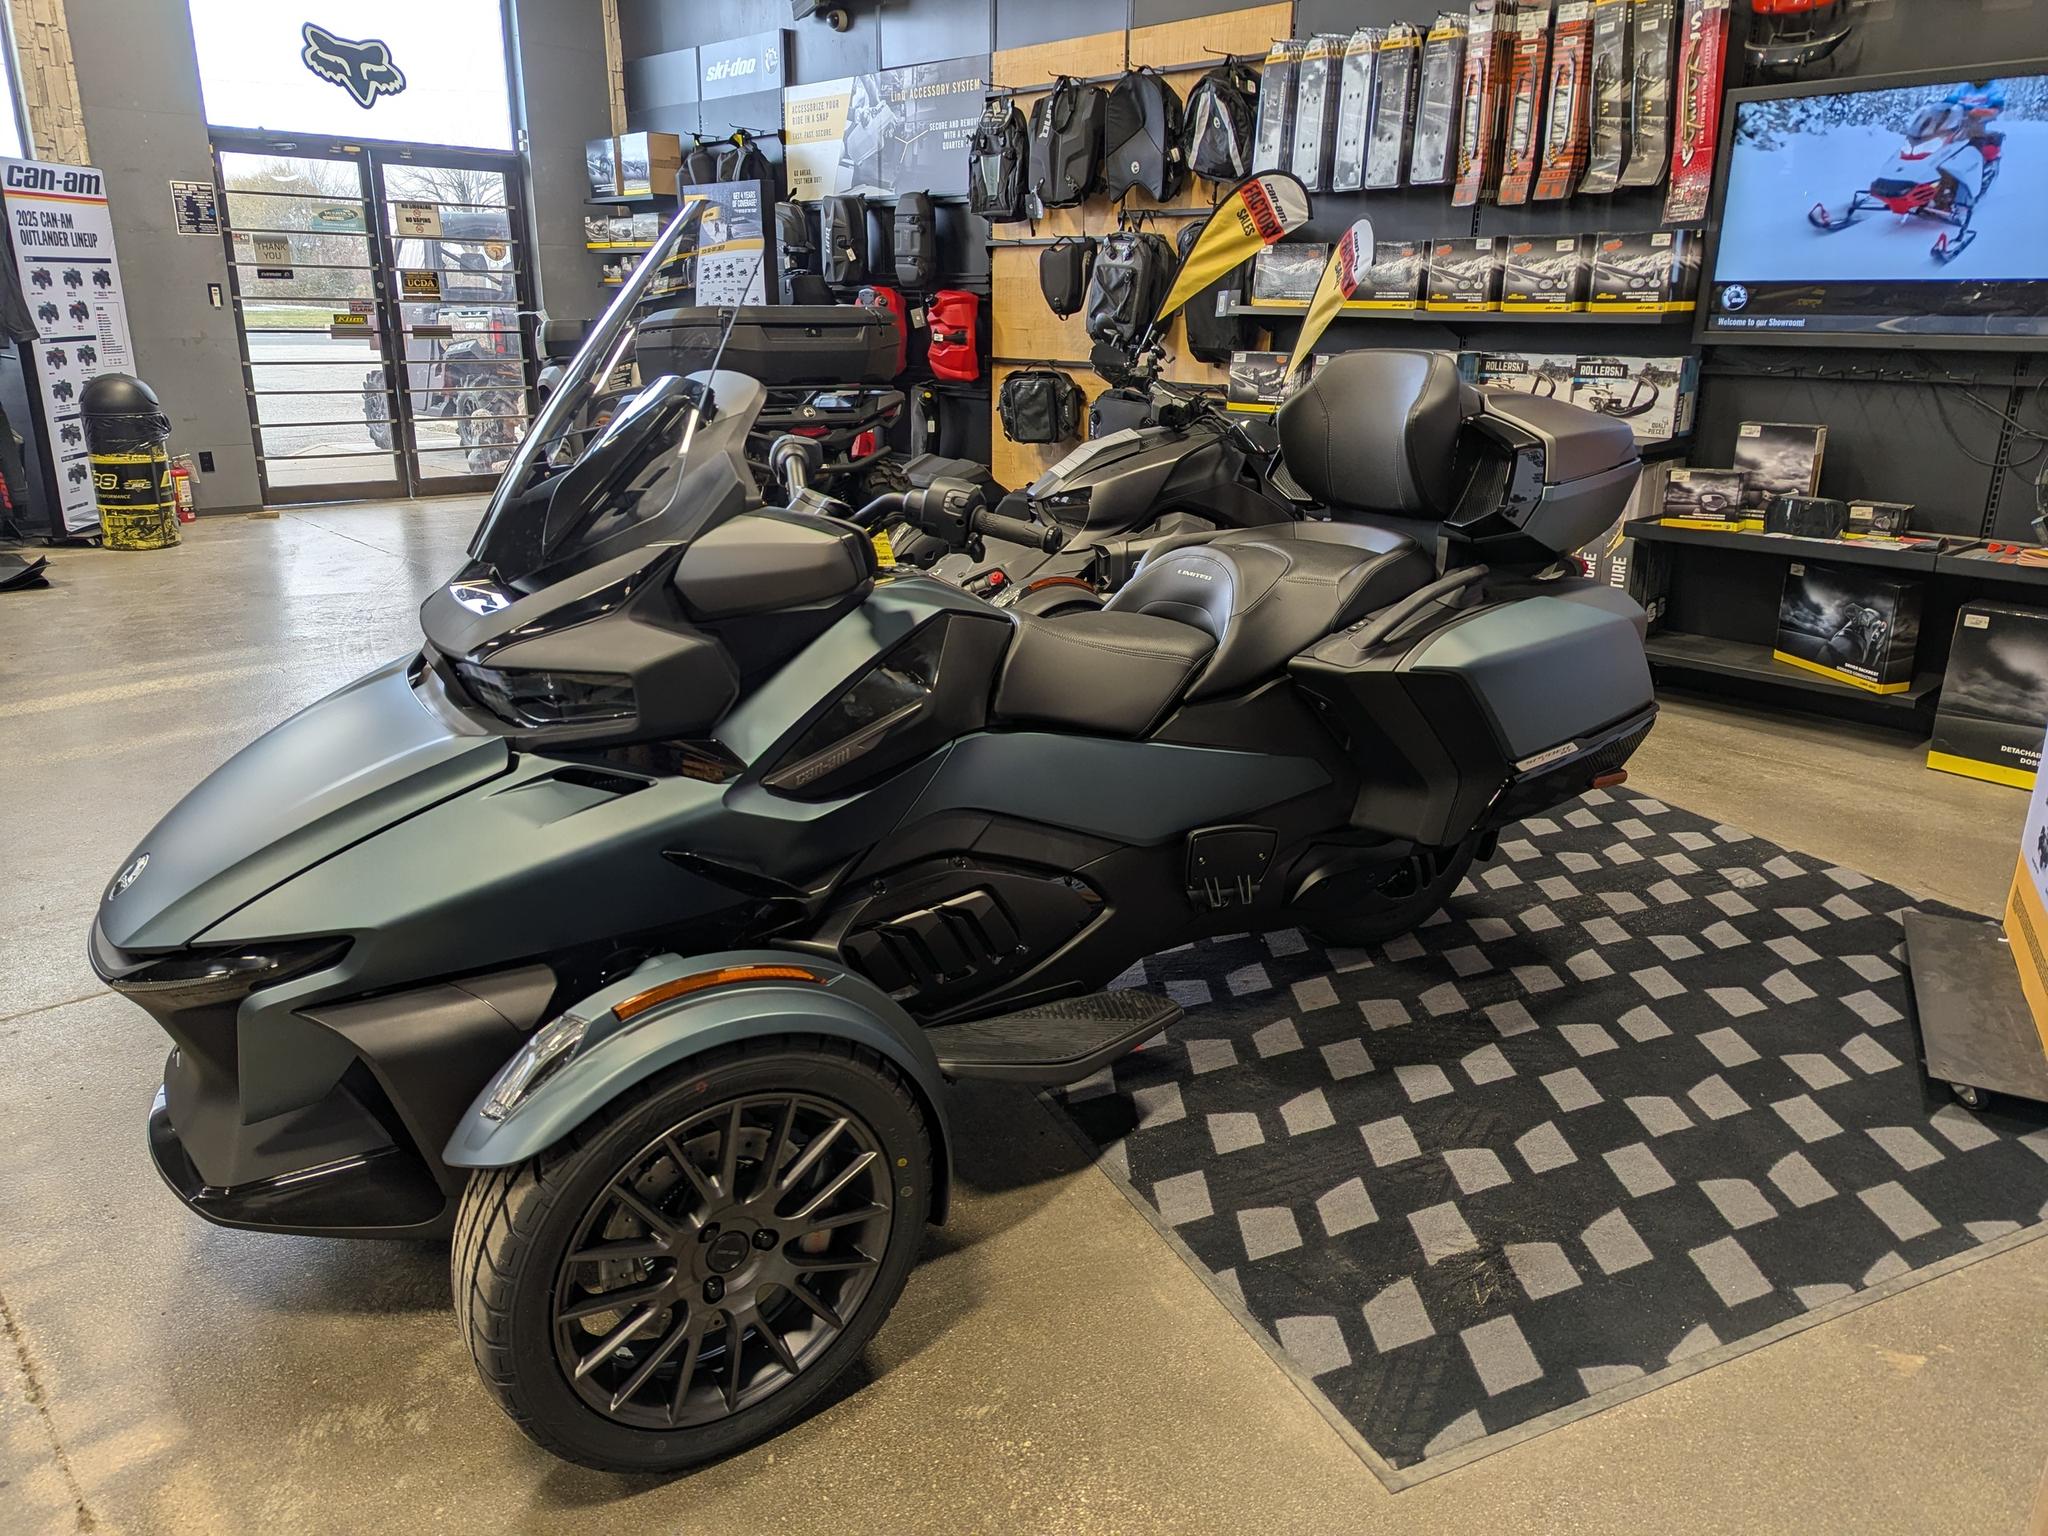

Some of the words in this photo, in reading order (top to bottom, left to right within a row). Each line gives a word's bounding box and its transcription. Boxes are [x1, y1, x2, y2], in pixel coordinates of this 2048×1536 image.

[706, 57, 756, 81] ski-doo
[909, 83, 950, 99] ACCESSORY
[952, 78, 981, 94] SYSTEM
[792, 101, 824, 114] ACCESSORIZE
[826, 99, 839, 109] YOUR
[792, 115, 803, 125] RIDE
[816, 112, 829, 122] SNAP
[929, 120, 948, 131] SECURE
[949, 119, 959, 129] AND
[943, 130, 957, 140] WITH
[942, 140, 964, 150] QUARTER
[7, 165, 101, 195] can-am
[1264, 183, 1288, 224] can-am
[1243, 183, 1283, 239] FACTORY
[16, 209, 39, 227] 2025
[40, 211, 74, 229] CAN-AM
[1236, 208, 1255, 237] SALES
[20, 229, 70, 247] OUTLANDER
[70, 231, 98, 248] LINEUP
[258, 241, 286, 251] THANK
[264, 252, 282, 260] YOU
[407, 278, 435, 288] UCDA
[1718, 317, 1747, 326] Welcome
[1748, 318, 1755, 326] to
[1768, 318, 1806, 327] Showroom!
[1485, 360, 1524, 372] ROLLERSKI
[1580, 364, 1623, 376] ROLLERSKI
[1177, 569, 1213, 581] LIMITED
[2001, 745, 2043, 759] DETACHAB
[796, 748, 850, 785] can-am
